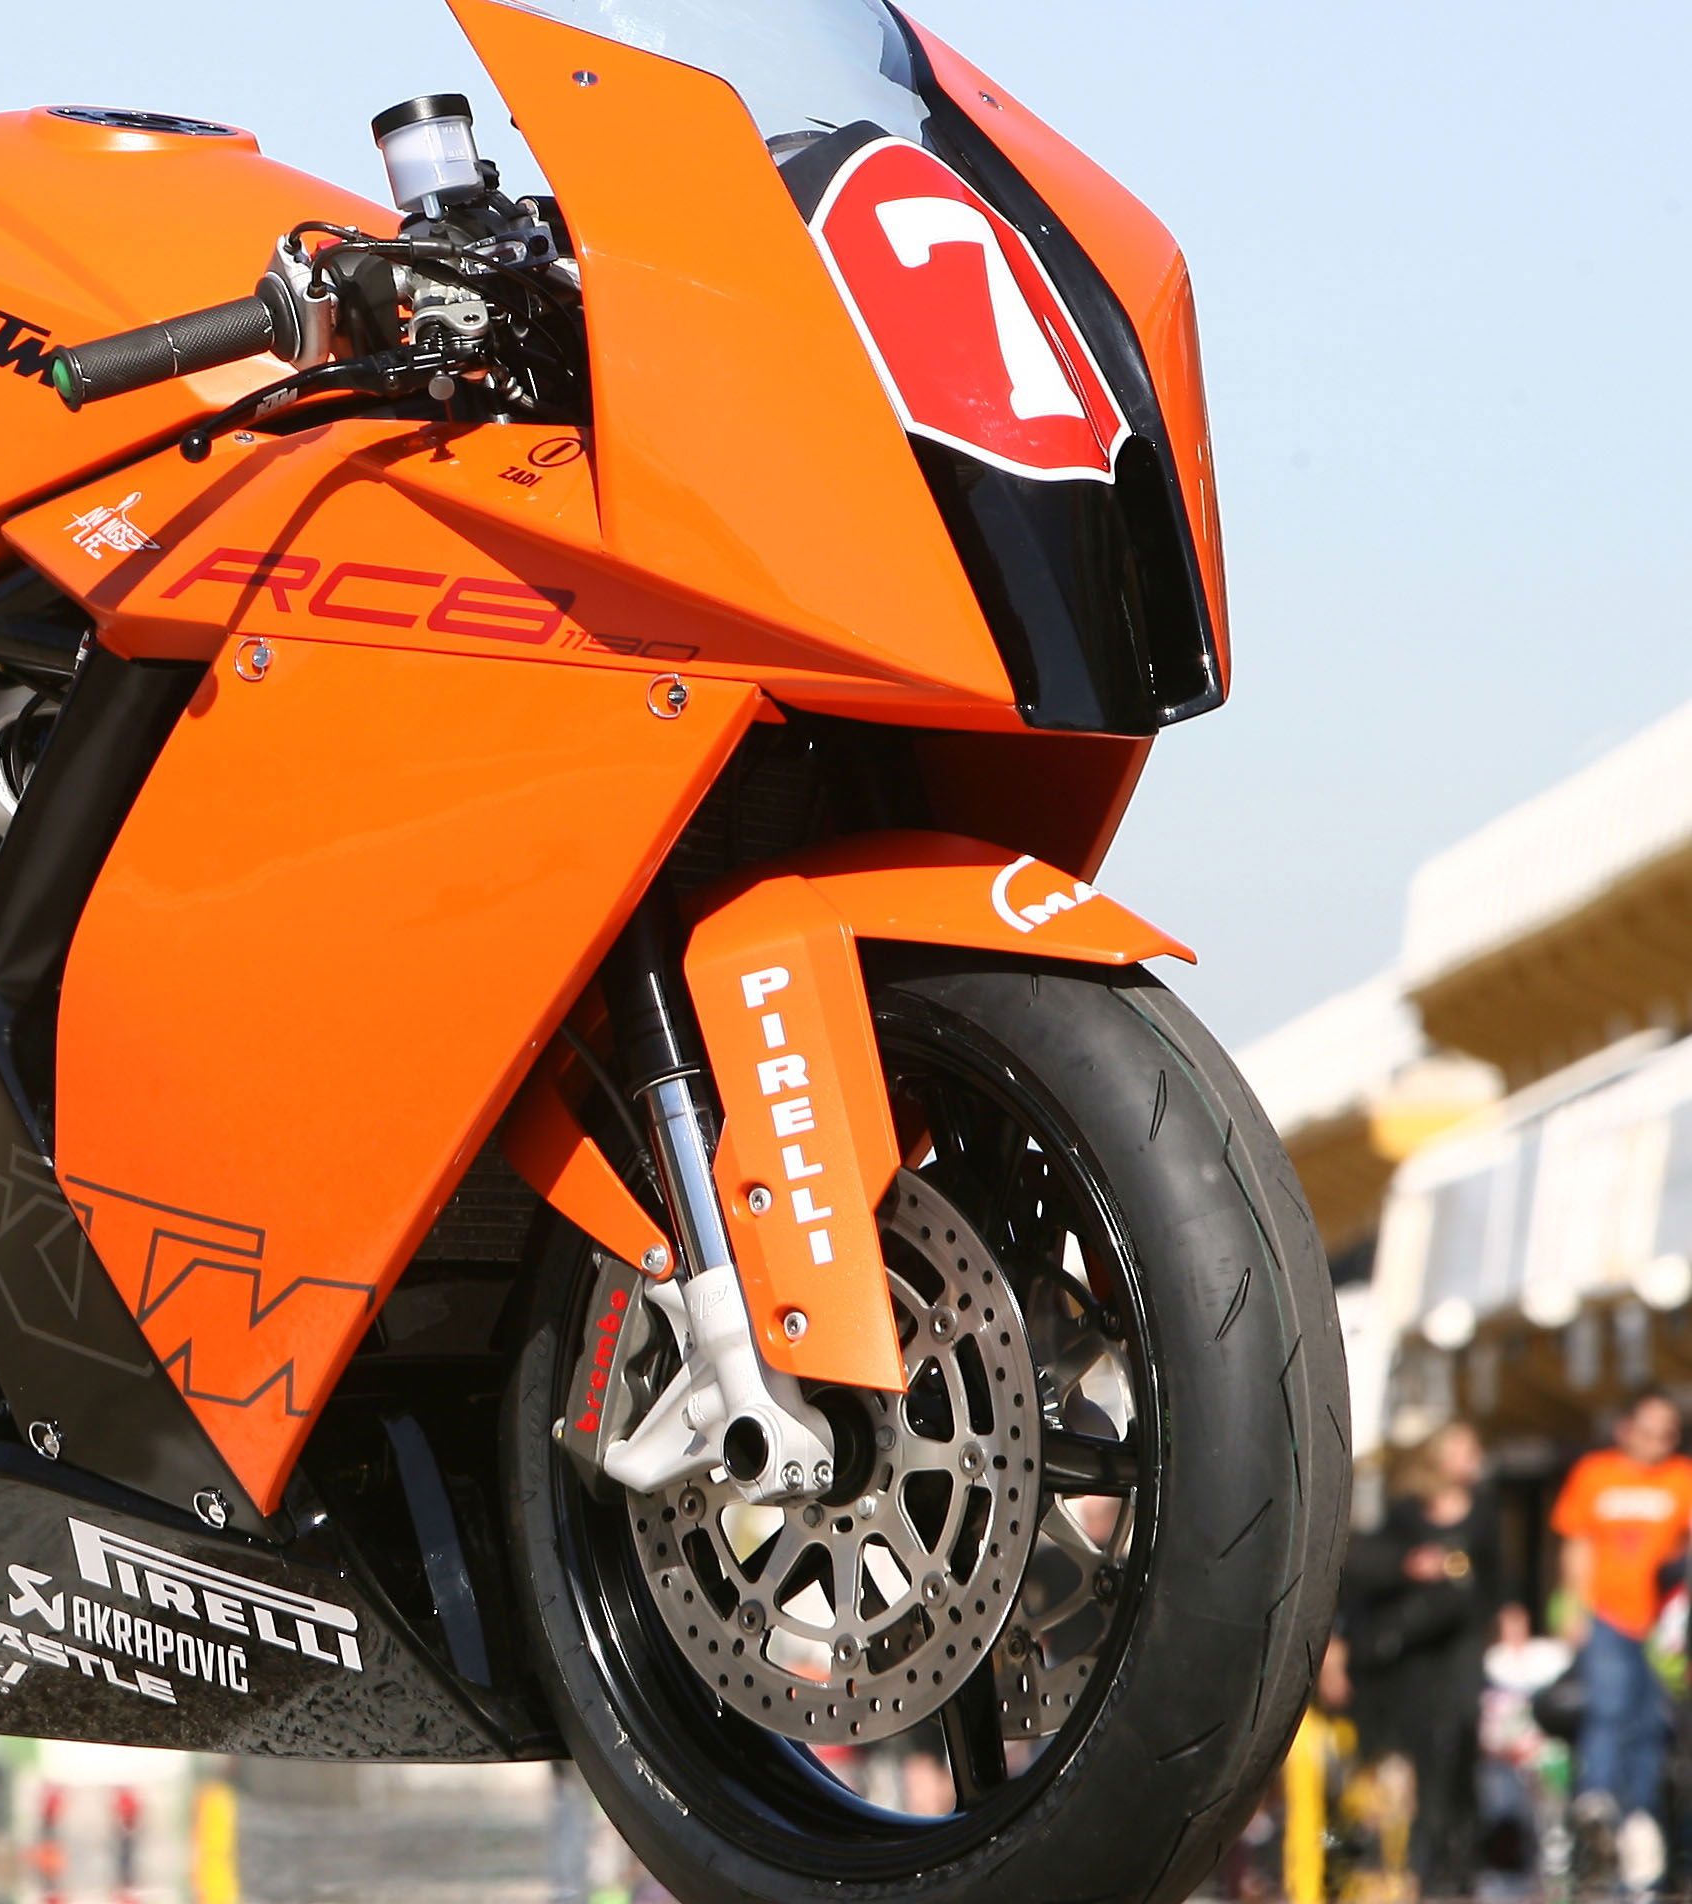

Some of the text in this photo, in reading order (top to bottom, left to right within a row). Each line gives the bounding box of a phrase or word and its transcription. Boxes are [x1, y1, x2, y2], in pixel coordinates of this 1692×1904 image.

[874, 196, 1085, 421] 7
[498, 466, 543, 488] ZADI
[159, 547, 701, 664] RC8 1190
[740, 966, 835, 1266] PIRELLI
[575, 1288, 628, 1433] brembo
[67, 1516, 364, 1673] PIRELLI
